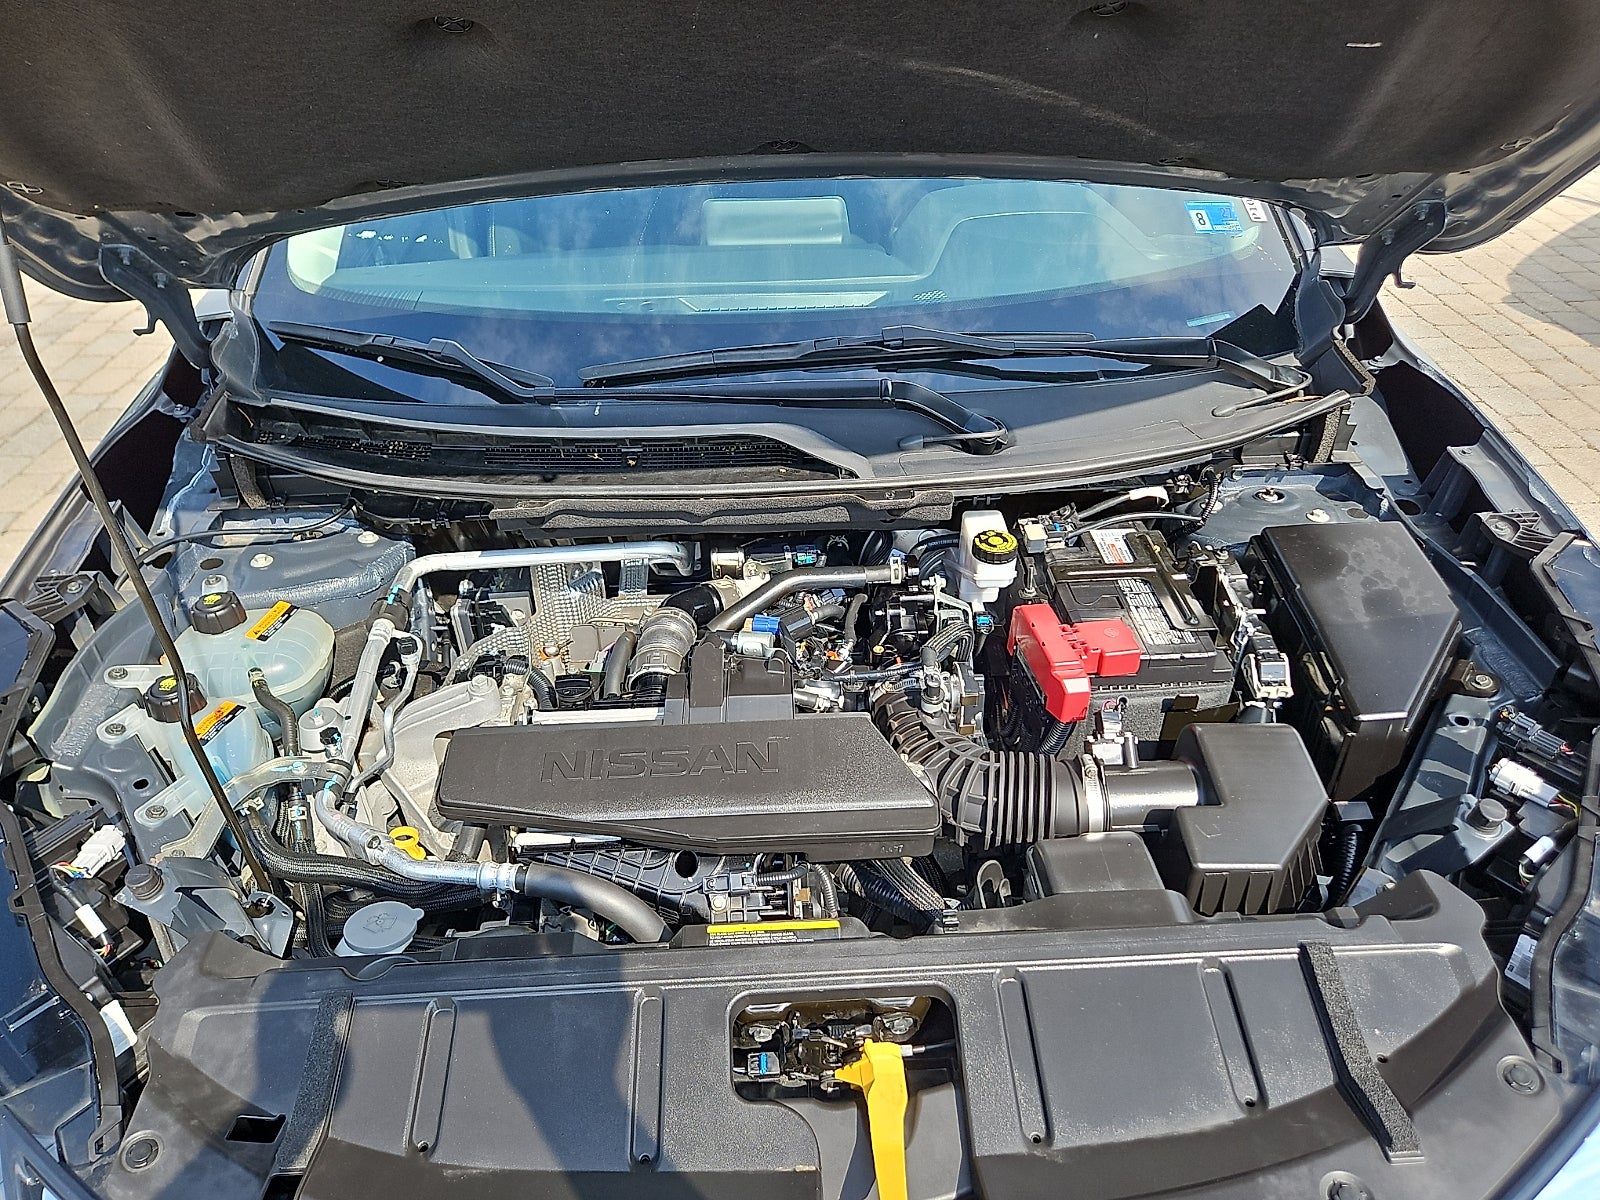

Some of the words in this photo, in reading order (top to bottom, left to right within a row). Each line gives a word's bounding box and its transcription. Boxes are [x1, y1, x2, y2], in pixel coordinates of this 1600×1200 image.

[1195, 212, 1206, 226] 8
[1219, 207, 1233, 219] 27
[540, 740, 780, 783] NISSAN
